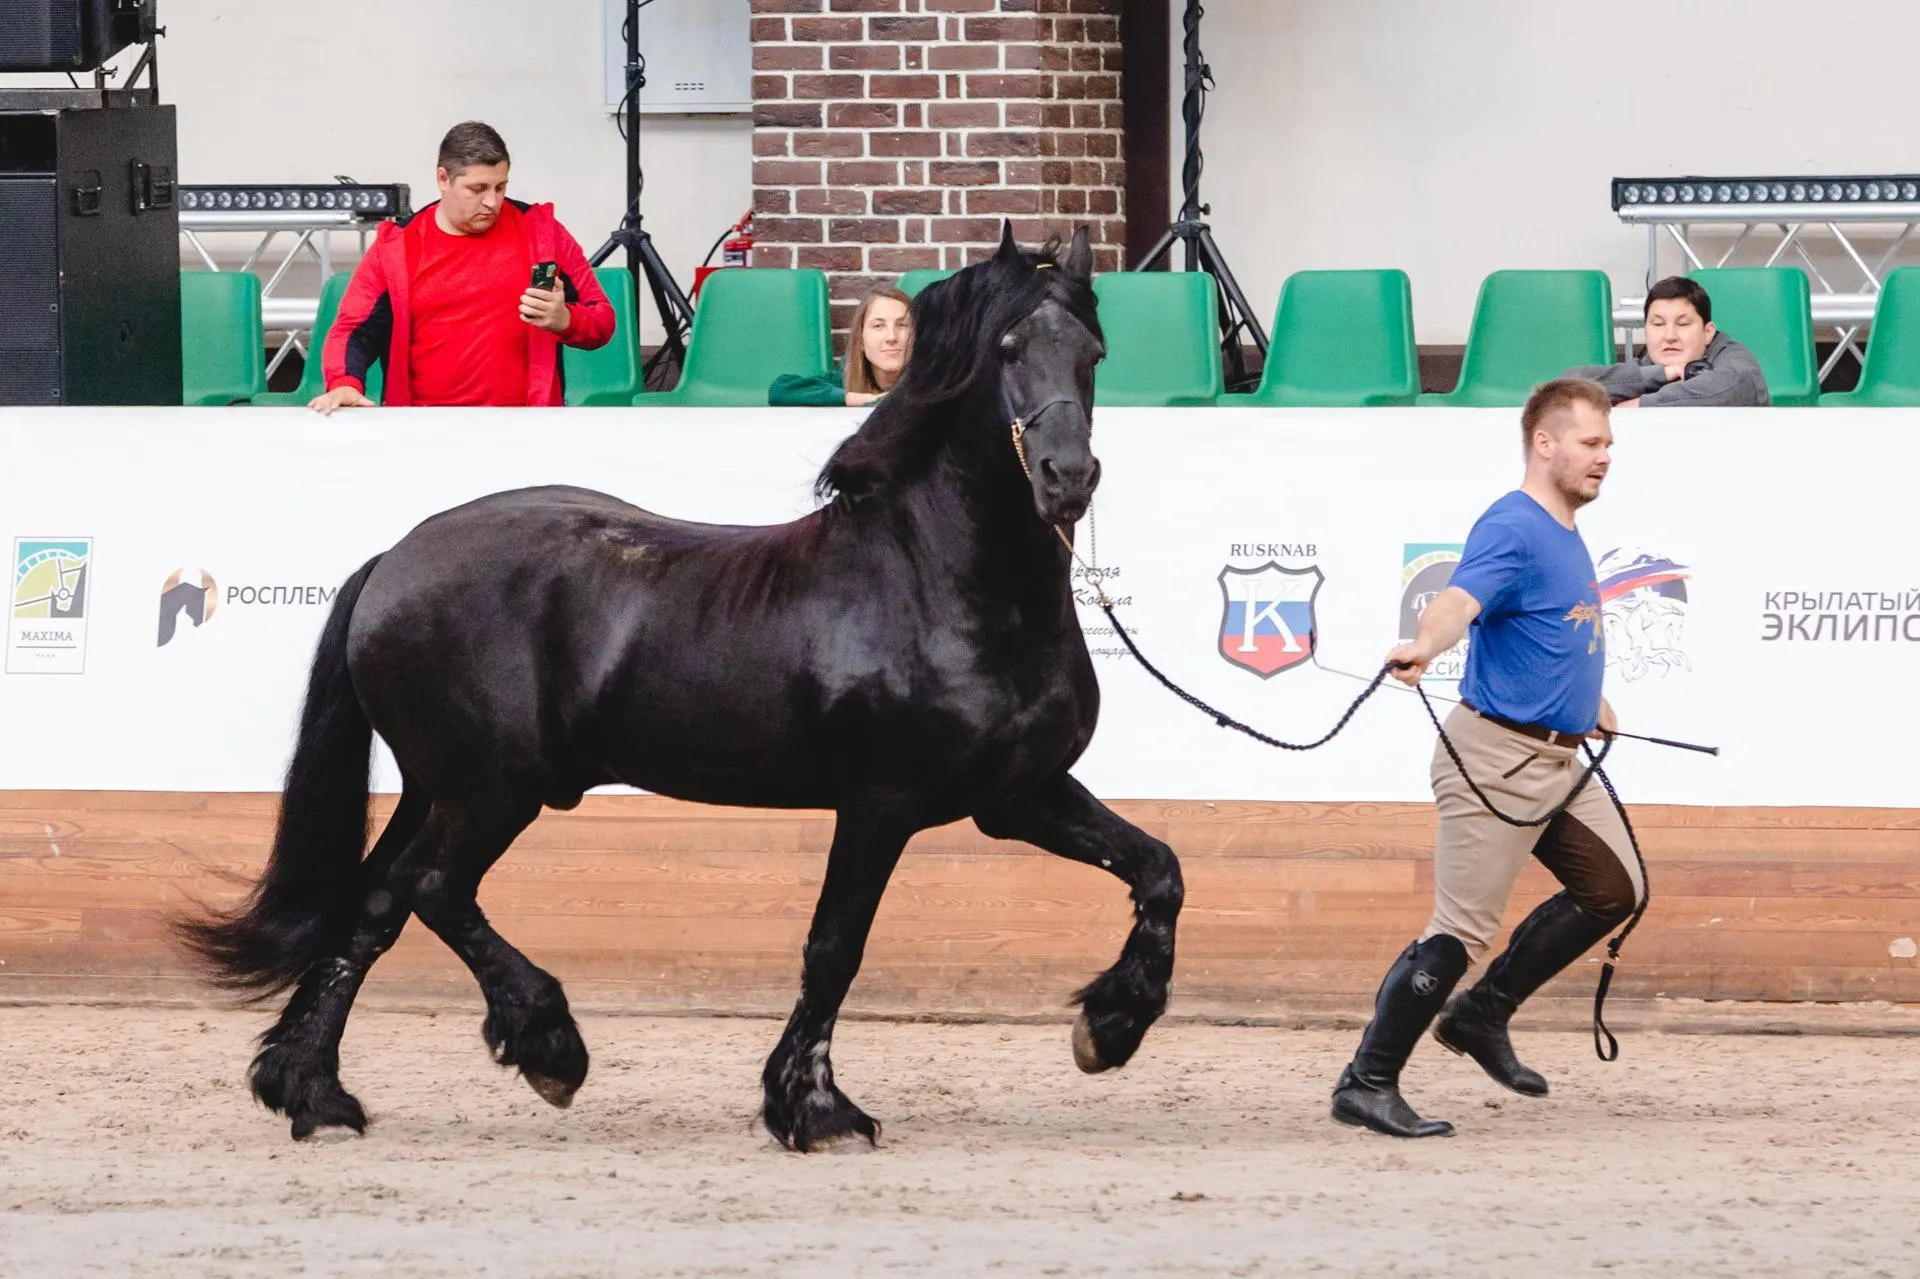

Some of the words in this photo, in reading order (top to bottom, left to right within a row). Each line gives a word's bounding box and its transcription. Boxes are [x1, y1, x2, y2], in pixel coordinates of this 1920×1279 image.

[1230, 543, 1317, 557] RUSKNAB
[1764, 587, 1920, 611] КРЫЛАТЫЙ
[20, 631, 74, 641] MAXIMA
